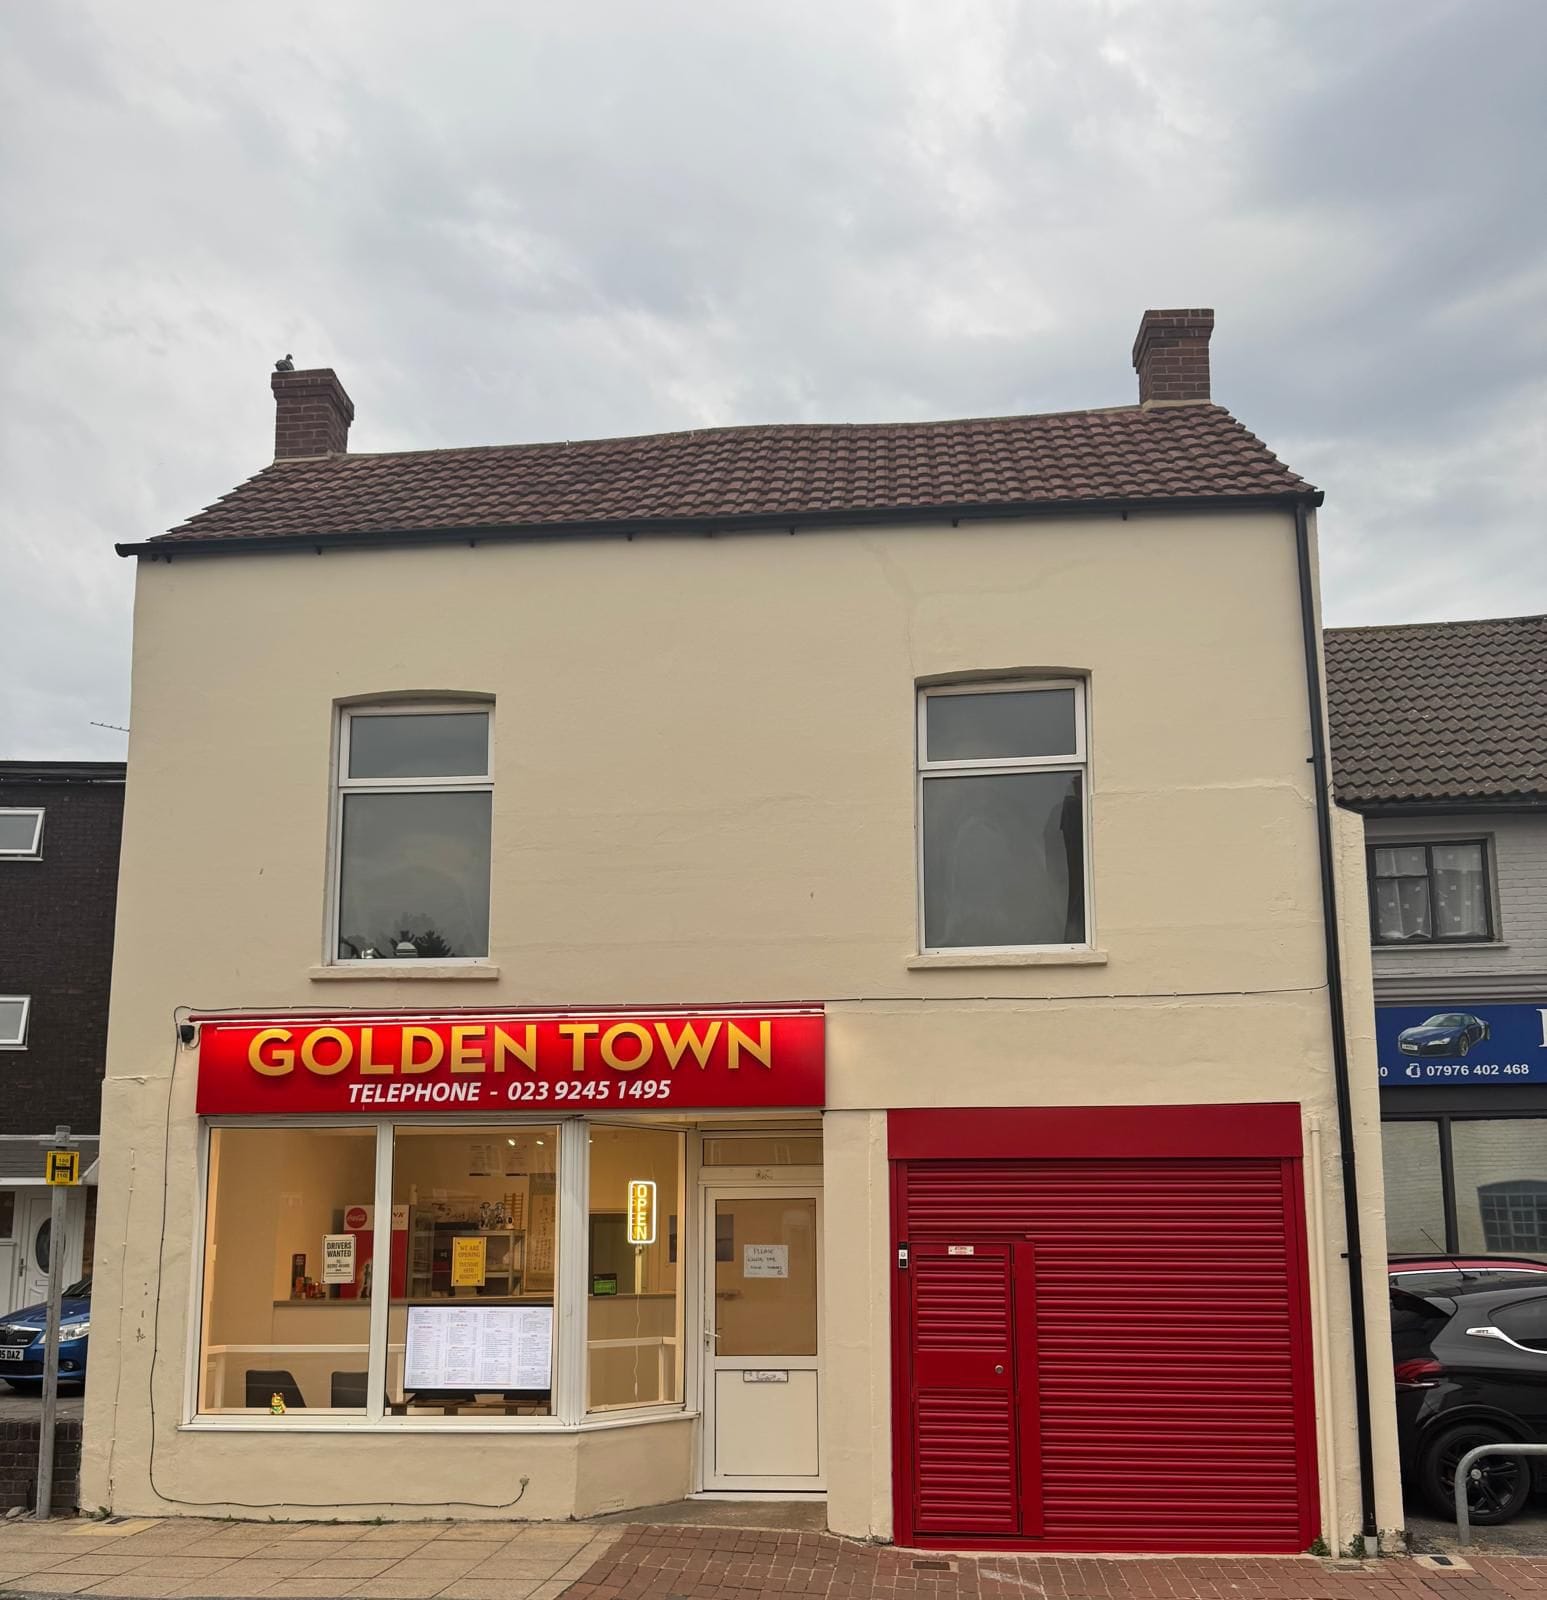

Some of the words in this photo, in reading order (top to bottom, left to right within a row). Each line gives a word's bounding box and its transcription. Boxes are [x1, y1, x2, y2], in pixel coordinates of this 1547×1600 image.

[248, 1024, 537, 1076] GOLDEN
[559, 1021, 771, 1072] TOWN
[1427, 1065, 1469, 1076] 07976
[1473, 1064, 1499, 1076] 402
[1503, 1064, 1529, 1075] 468
[349, 1082, 481, 1103] TELEPHONE
[507, 1081, 548, 1101] 023
[554, 1080, 610, 1100] 9245
[617, 1079, 671, 1099] 1495
[636, 1184, 648, 1241] OPEN
[326, 1242, 352, 1250] DRIVERS
[327, 1250, 352, 1258] WANTED
[7, 1350, 21, 1360] DAZ
